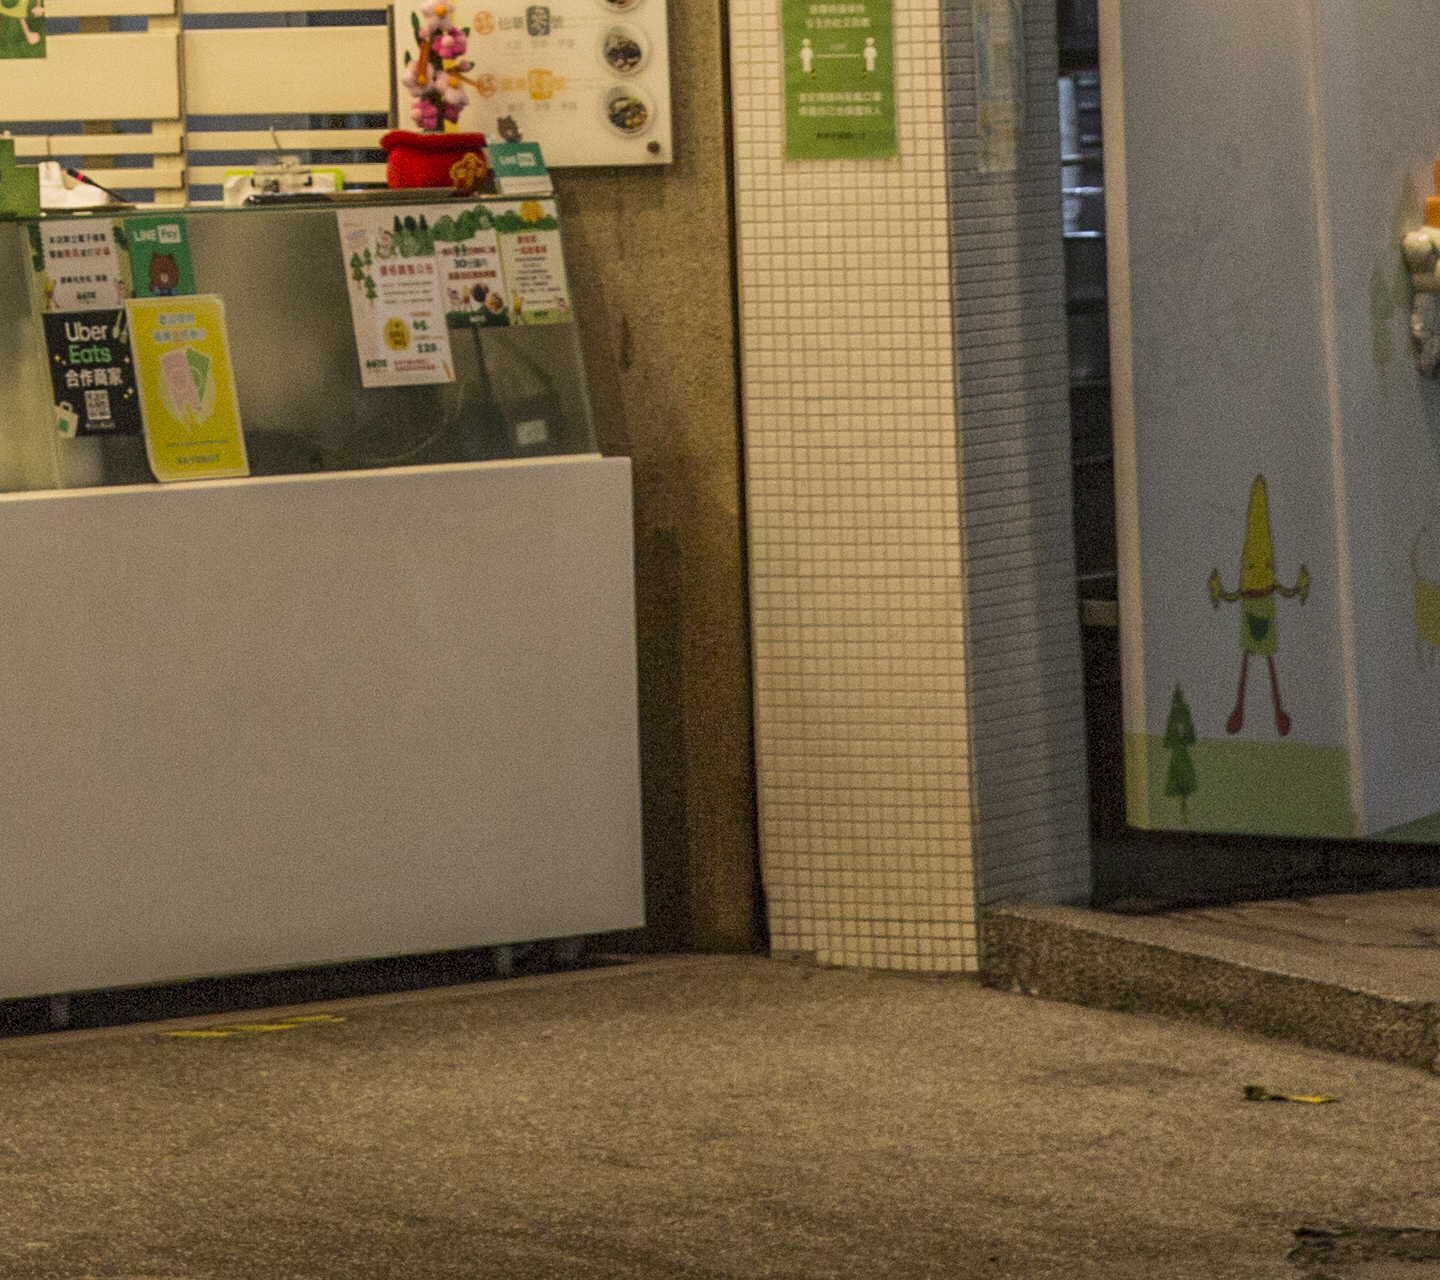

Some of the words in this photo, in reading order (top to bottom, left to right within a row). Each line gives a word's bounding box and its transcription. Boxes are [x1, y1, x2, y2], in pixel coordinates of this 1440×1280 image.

[64, 321, 108, 341] Uber
[69, 344, 112, 365] Eats
[65, 366, 123, 388] 合作商家
